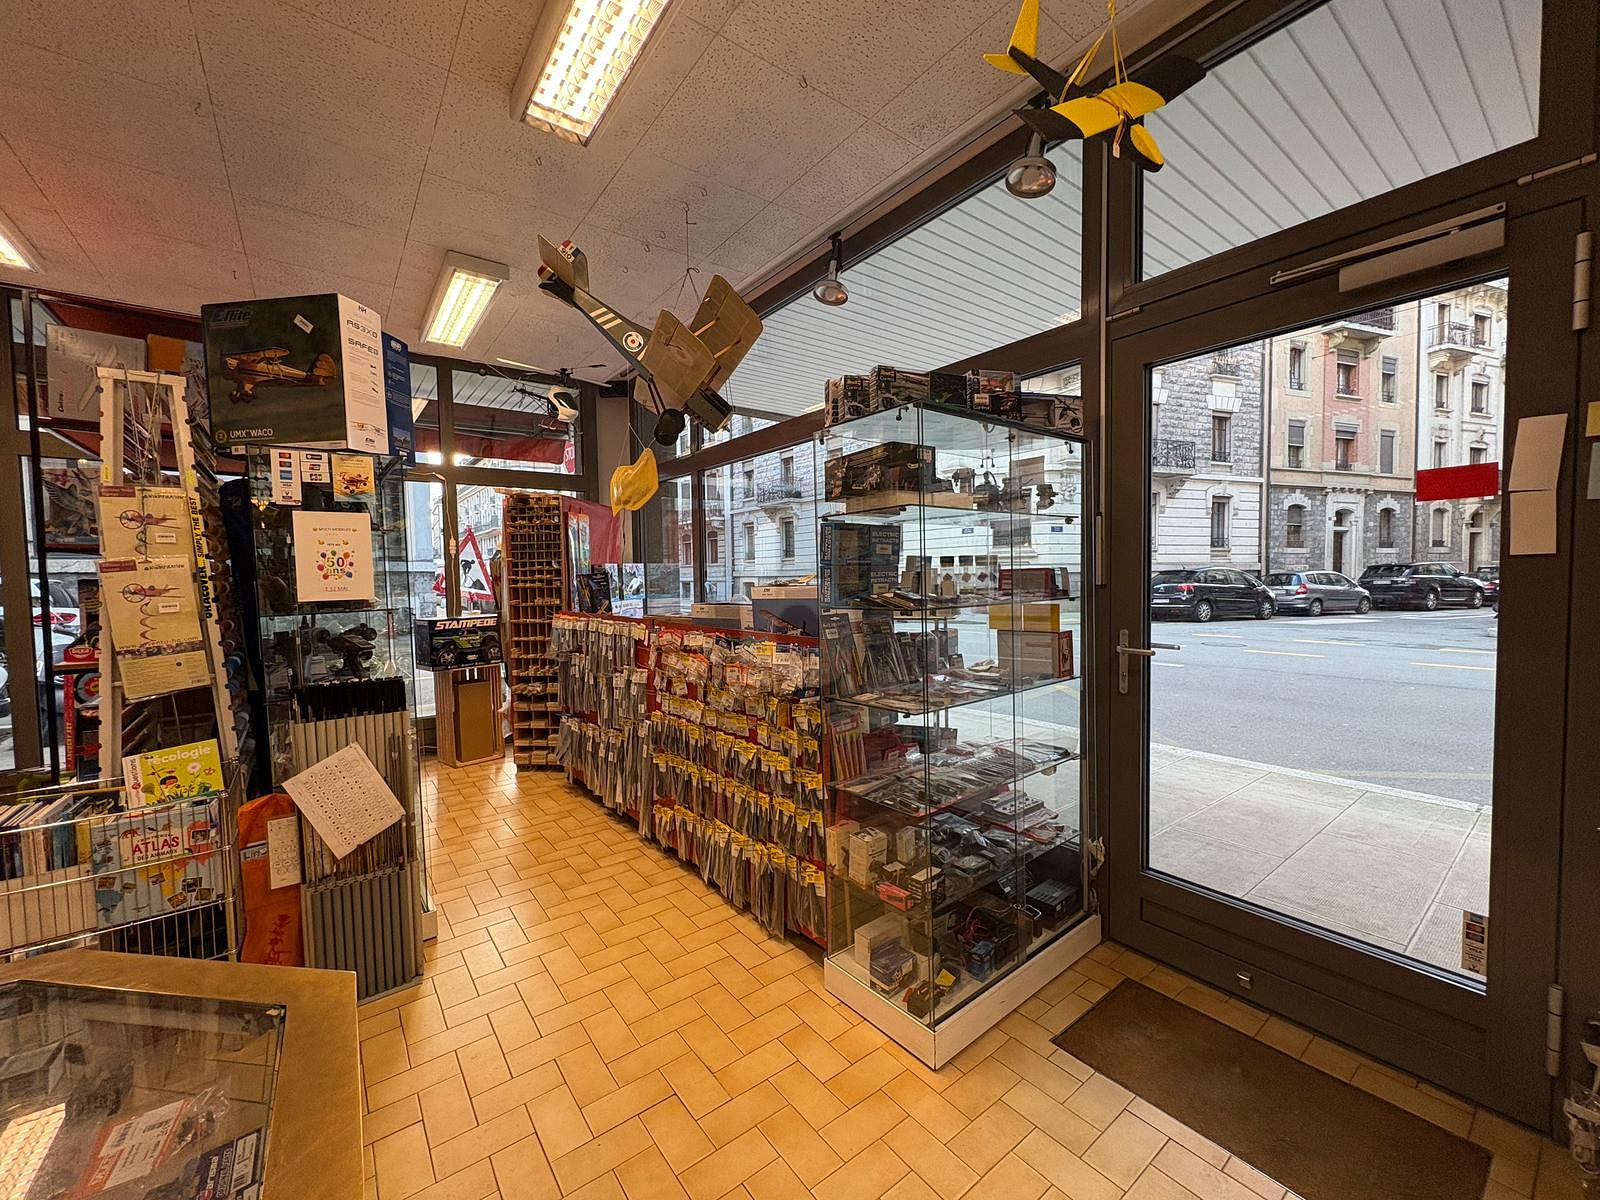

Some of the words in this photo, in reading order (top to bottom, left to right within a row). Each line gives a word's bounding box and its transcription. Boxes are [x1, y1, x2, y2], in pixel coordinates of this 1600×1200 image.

[250, 428, 274, 438] WACO
[189, 497, 199, 515] BEST
[193, 516, 201, 530] THE
[195, 532, 205, 558] SIMPLY
[326, 557, 345, 567] 50
[434, 618, 497, 631] STAMPEDE
[134, 836, 179, 855] ATLAS
